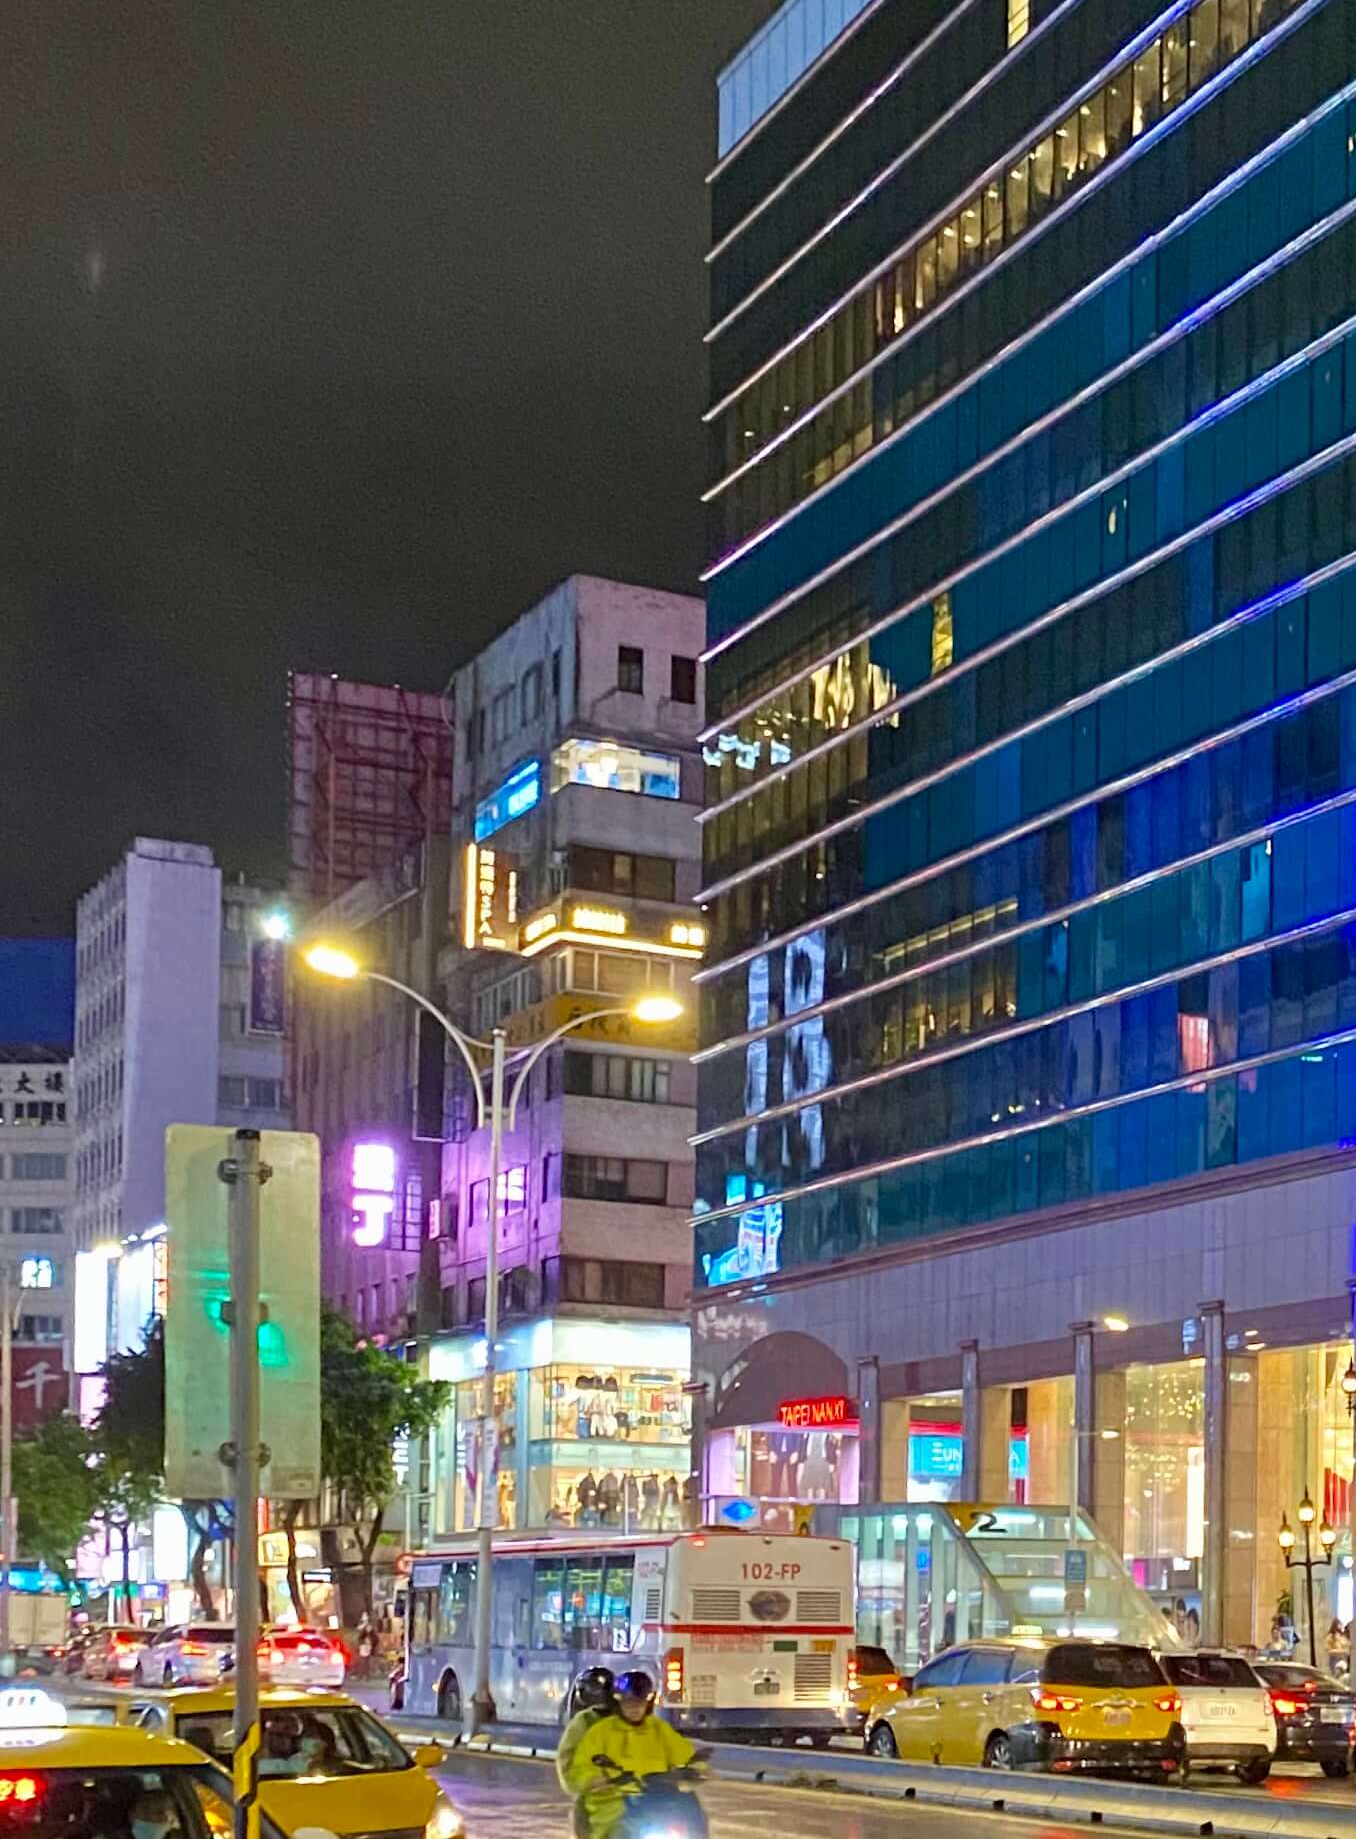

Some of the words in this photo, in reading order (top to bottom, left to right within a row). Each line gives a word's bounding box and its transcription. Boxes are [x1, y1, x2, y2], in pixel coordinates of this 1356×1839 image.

[0, 1071, 64, 1094] 大樓
[780, 1404, 811, 1426] TAIPEI
[970, 1511, 1008, 1533] 2
[741, 1563, 801, 1580] 102-FP
